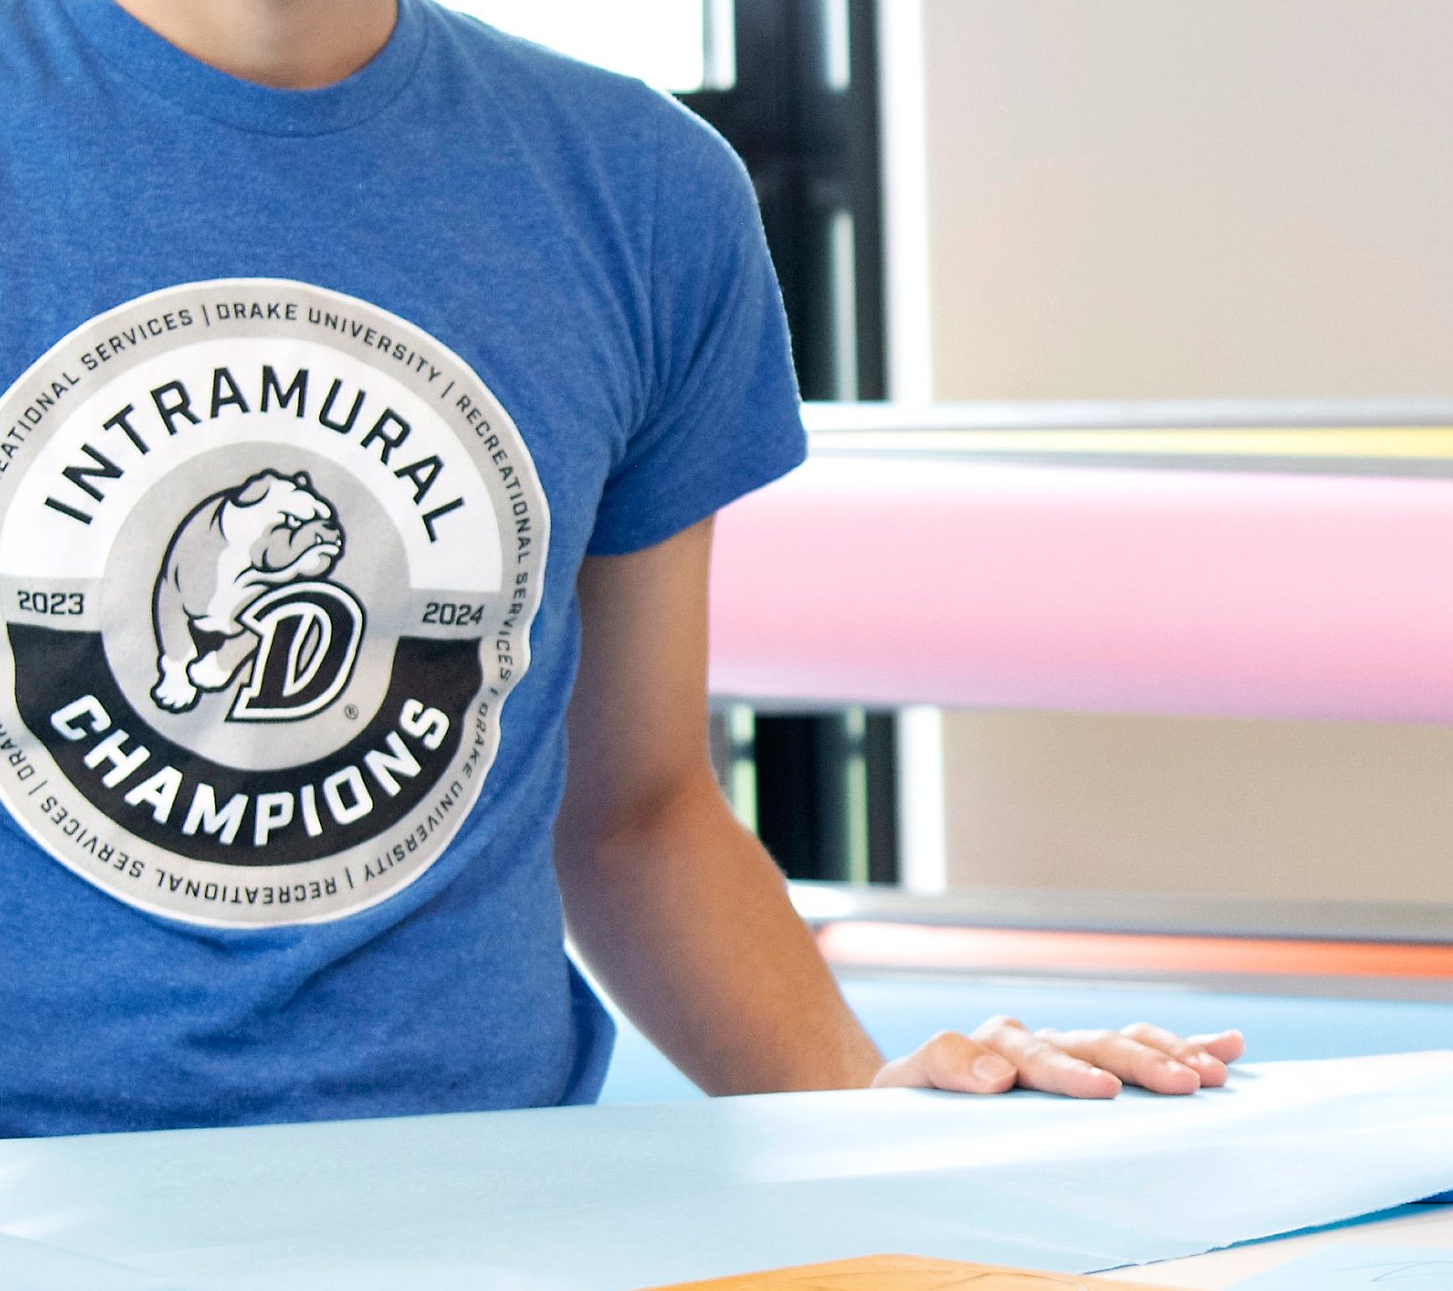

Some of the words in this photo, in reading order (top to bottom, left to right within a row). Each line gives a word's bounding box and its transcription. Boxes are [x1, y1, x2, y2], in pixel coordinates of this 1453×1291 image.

[80, 309, 194, 371] SERVICES
[216, 302, 298, 320] DRAKE
[309, 307, 442, 382] UNIVERSITY
[44, 364, 466, 543] INTRAMURAL
[456, 394, 532, 565] RECREATIONAL
[17, 589, 86, 616] 2023
[421, 601, 486, 627] 2024
[497, 571, 528, 682] SERVICES
[225, 581, 368, 724] D
[49, 694, 451, 847] CHAMPIONS
[40, 795, 146, 879] SERVICES
[364, 781, 464, 883] UNIVERSITY
[155, 868, 337, 904] RECREATIONAL
